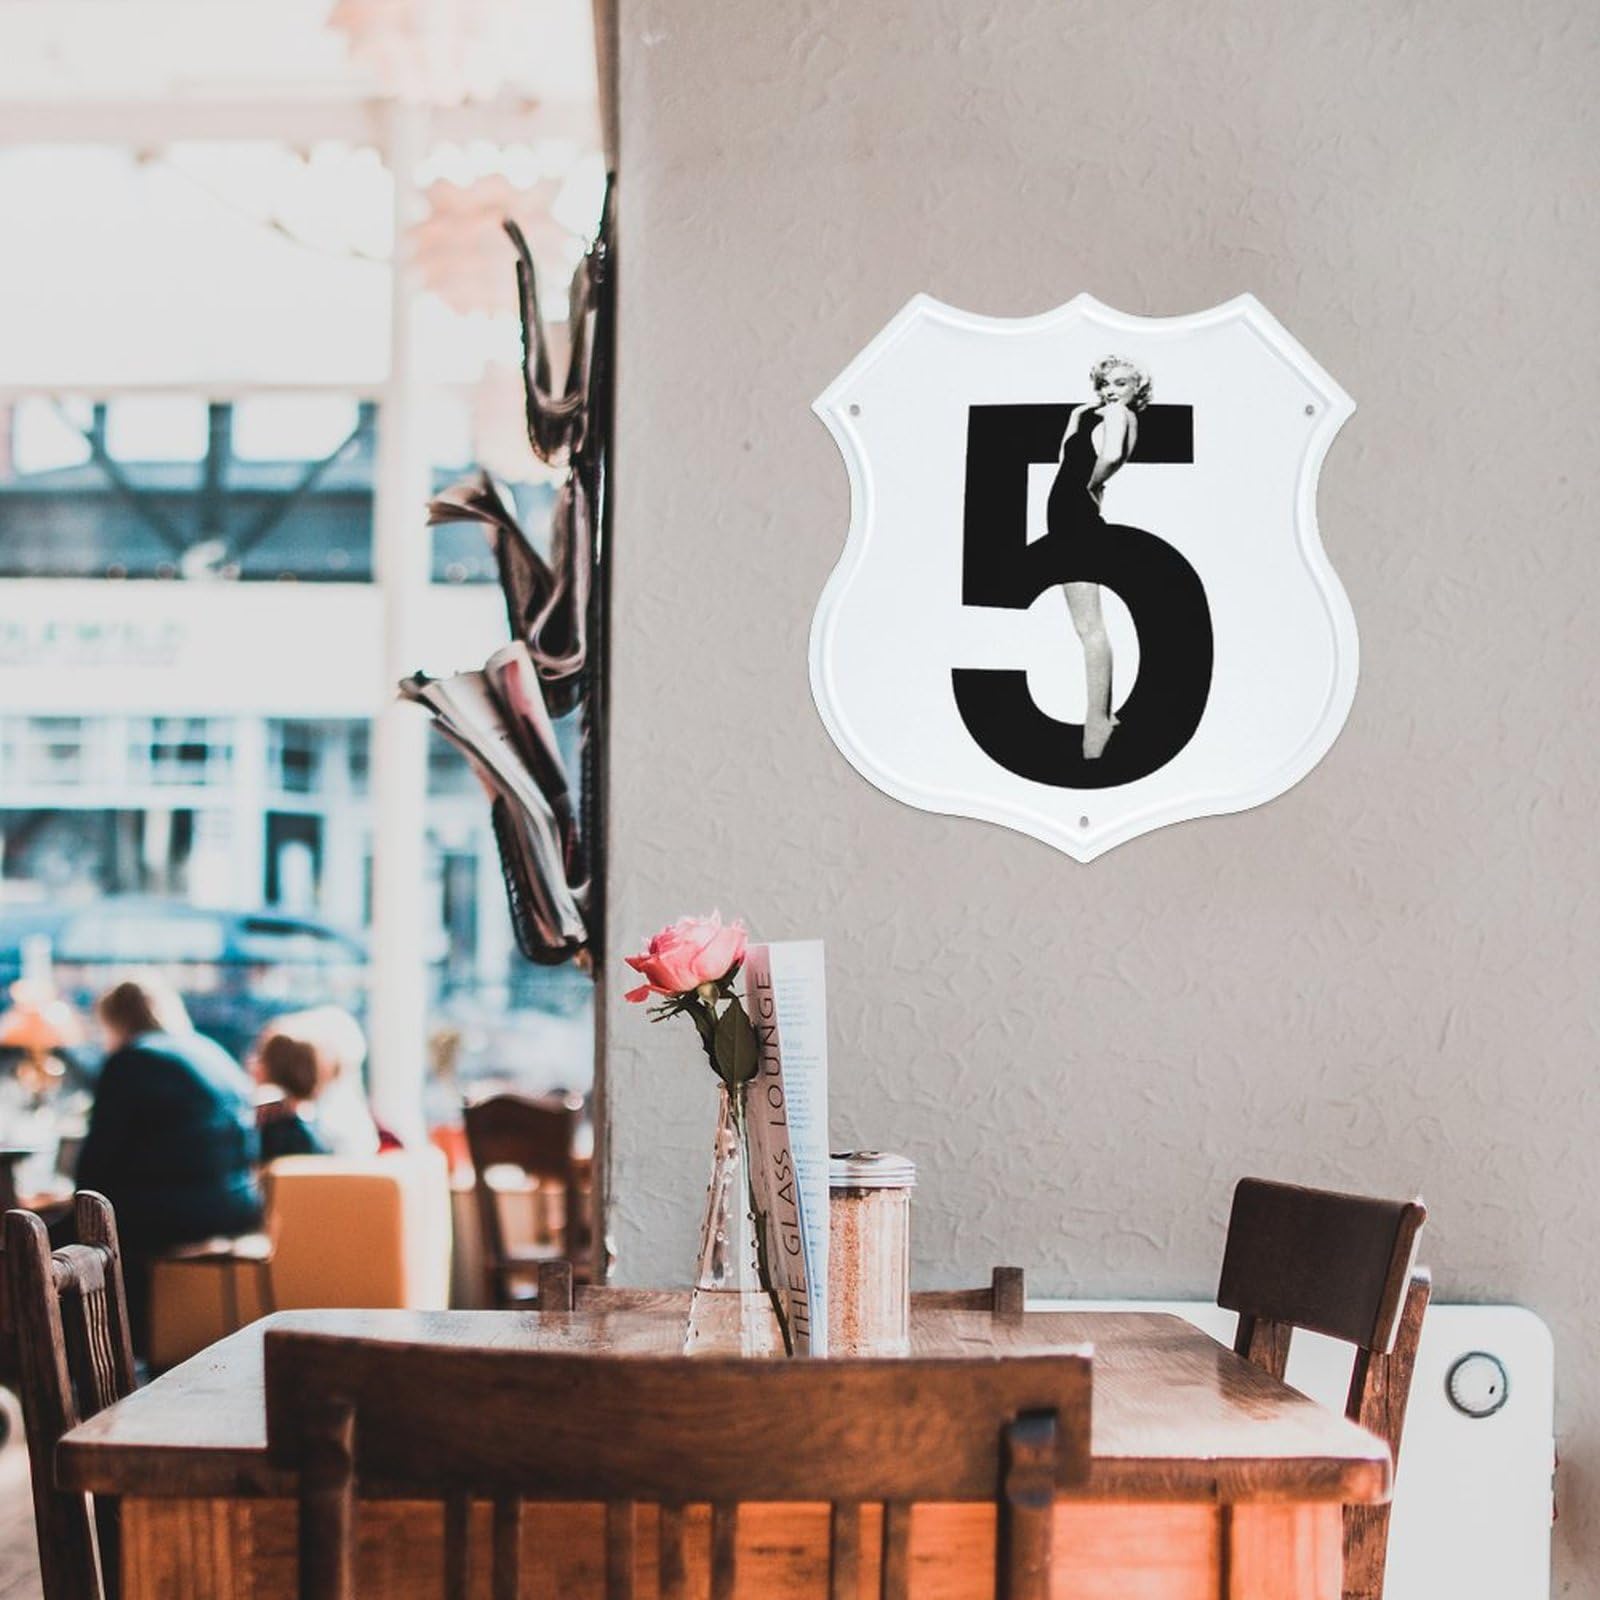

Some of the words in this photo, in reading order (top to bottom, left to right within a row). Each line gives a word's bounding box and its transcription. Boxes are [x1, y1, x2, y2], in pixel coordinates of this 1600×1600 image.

[951, 403, 1213, 789] 5
[756, 972, 786, 1126] LOUNGE
[772, 1149, 800, 1256] GLASS
[788, 1274, 809, 1339] THE
